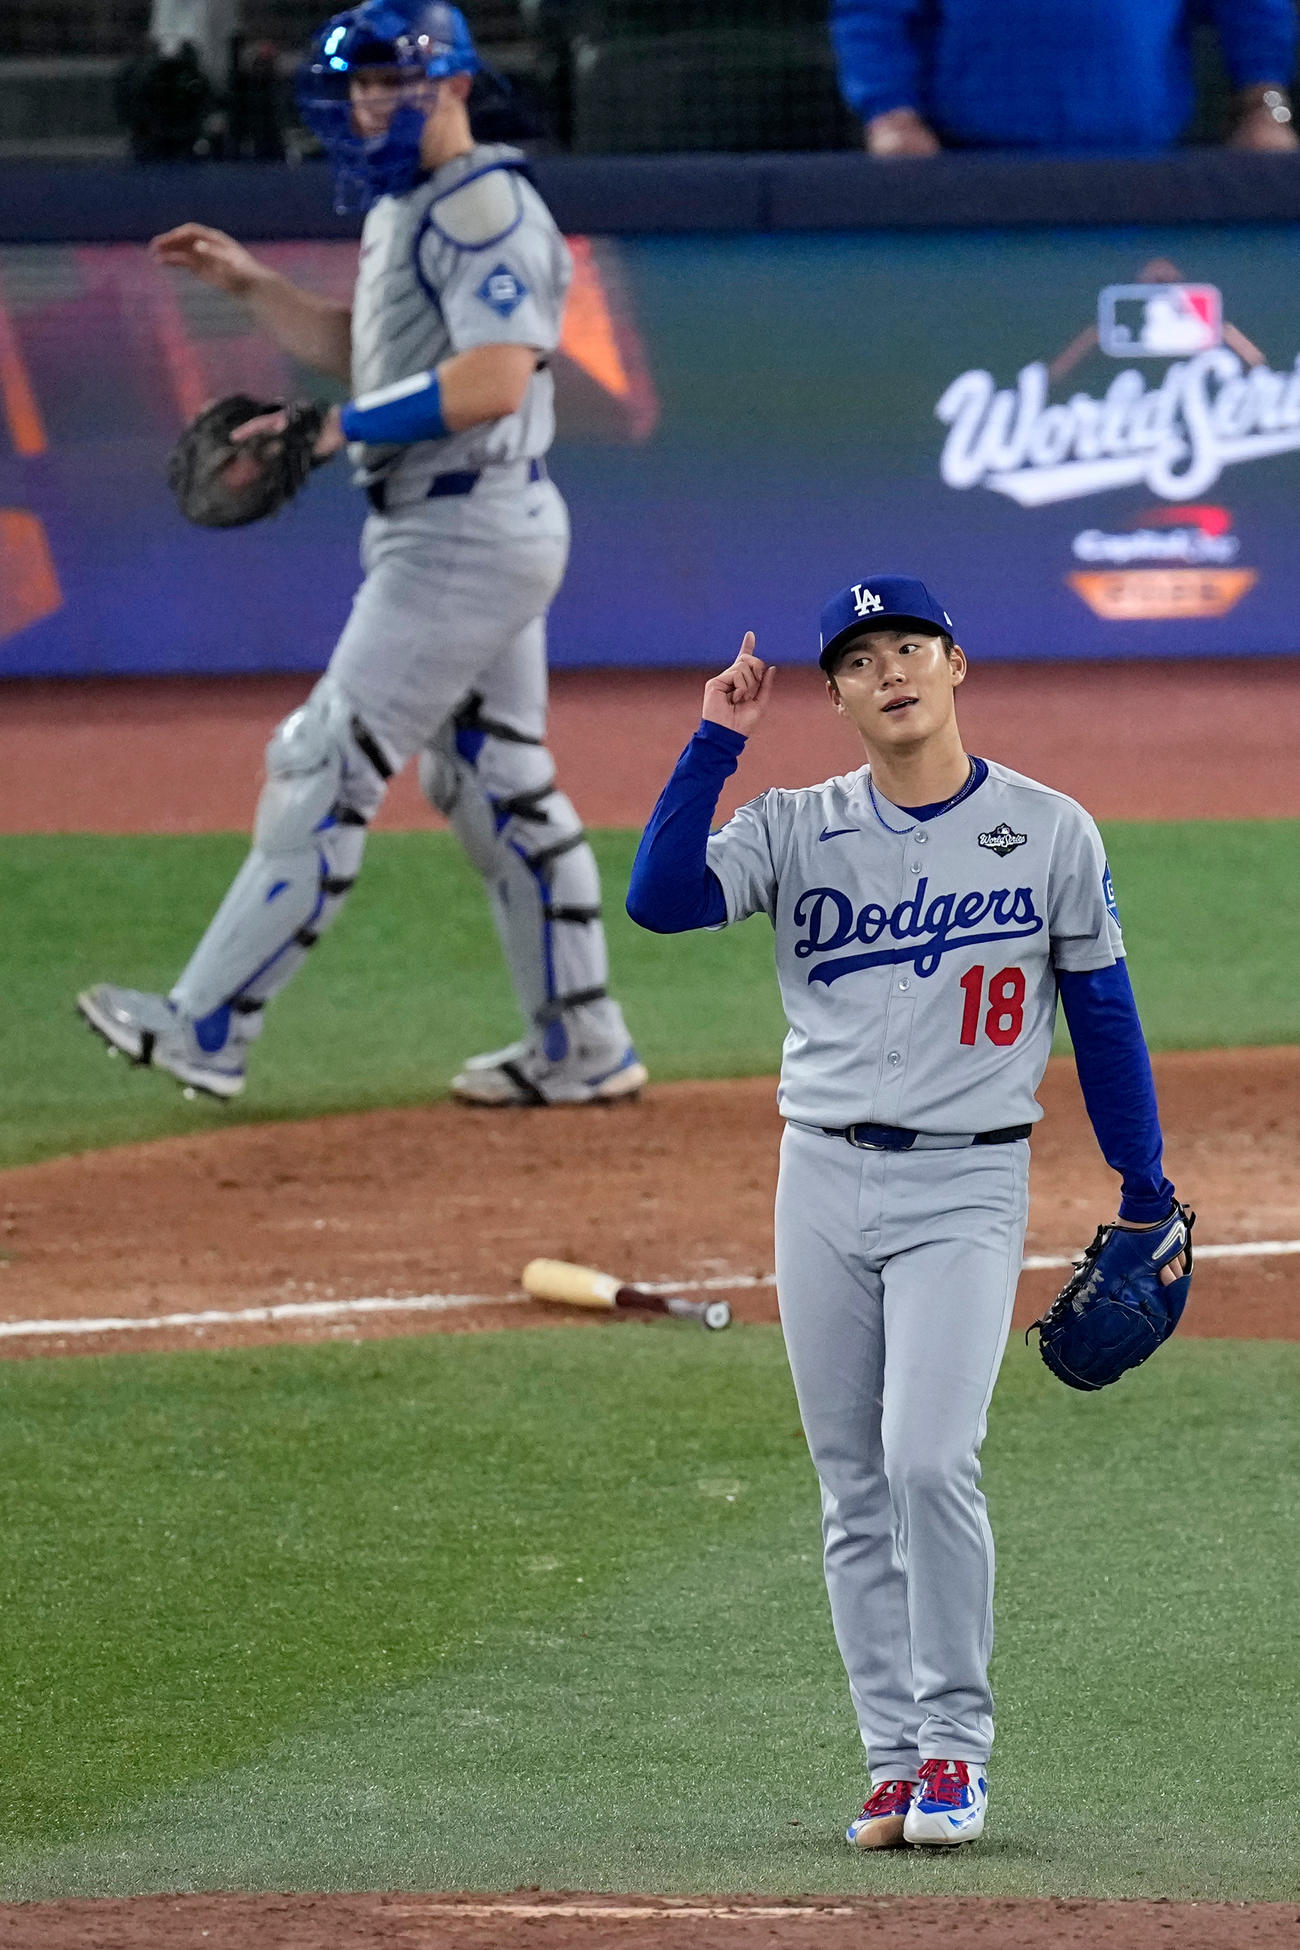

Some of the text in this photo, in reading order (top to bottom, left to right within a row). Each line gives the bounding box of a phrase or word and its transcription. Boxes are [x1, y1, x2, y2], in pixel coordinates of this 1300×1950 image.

[936, 362, 1184, 492] World
[851, 584, 884, 616] LA
[979, 833, 1026, 848] World Series
[793, 877, 1043, 984] Dodgers
[959, 965, 1026, 1046] 18
